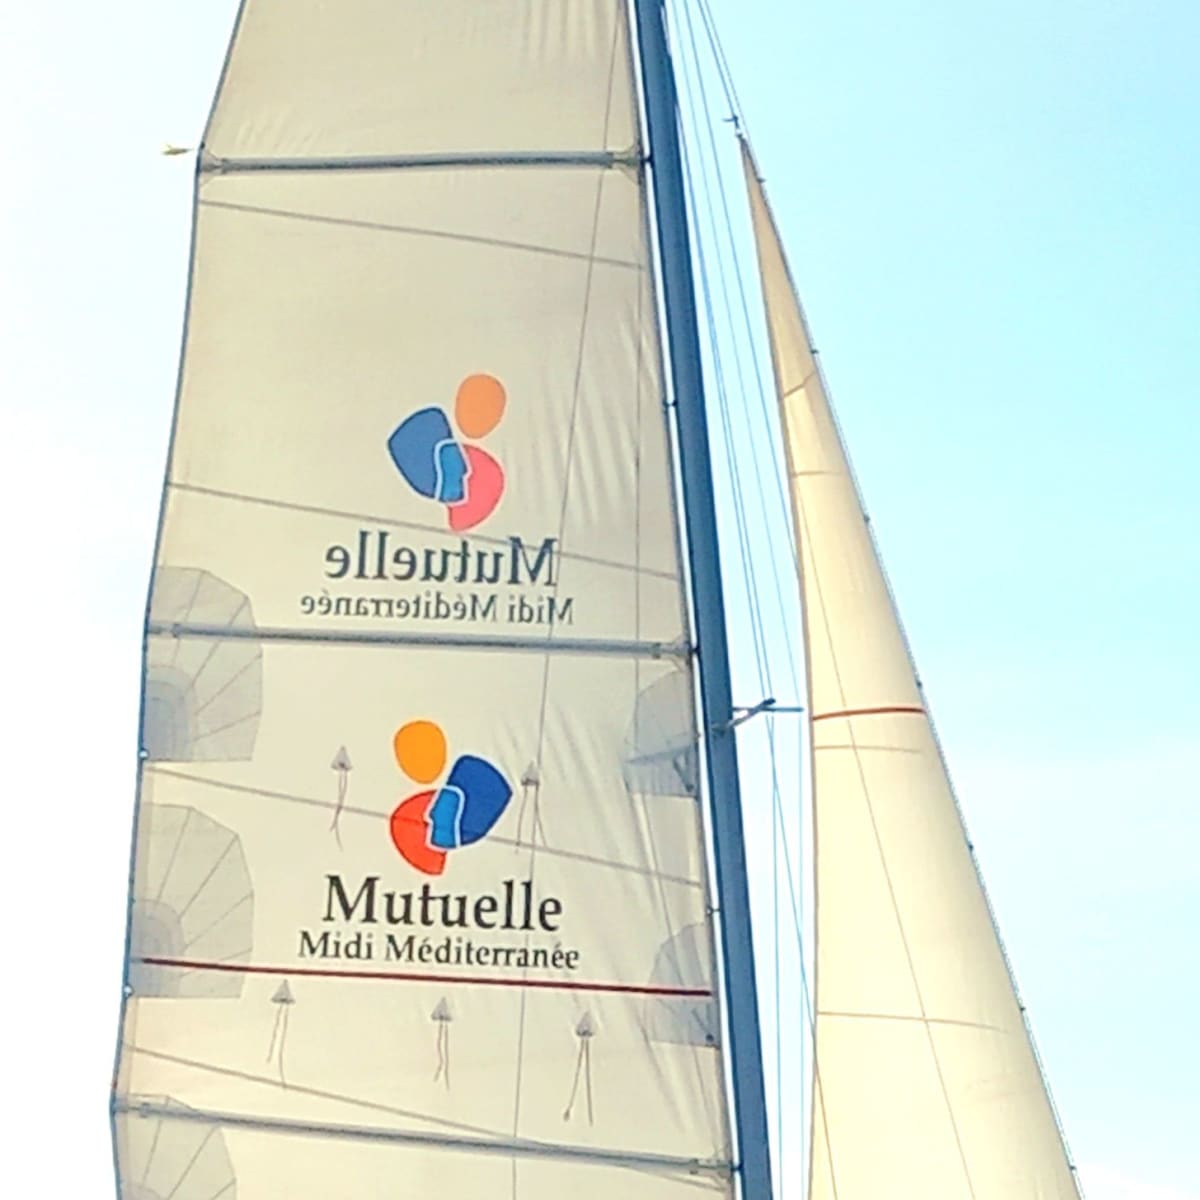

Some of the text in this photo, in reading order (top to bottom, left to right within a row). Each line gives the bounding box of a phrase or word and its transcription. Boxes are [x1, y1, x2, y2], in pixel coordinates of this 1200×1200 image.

[321, 874, 564, 932] Mutuelle
[298, 930, 580, 971] Midi Méditerranée
